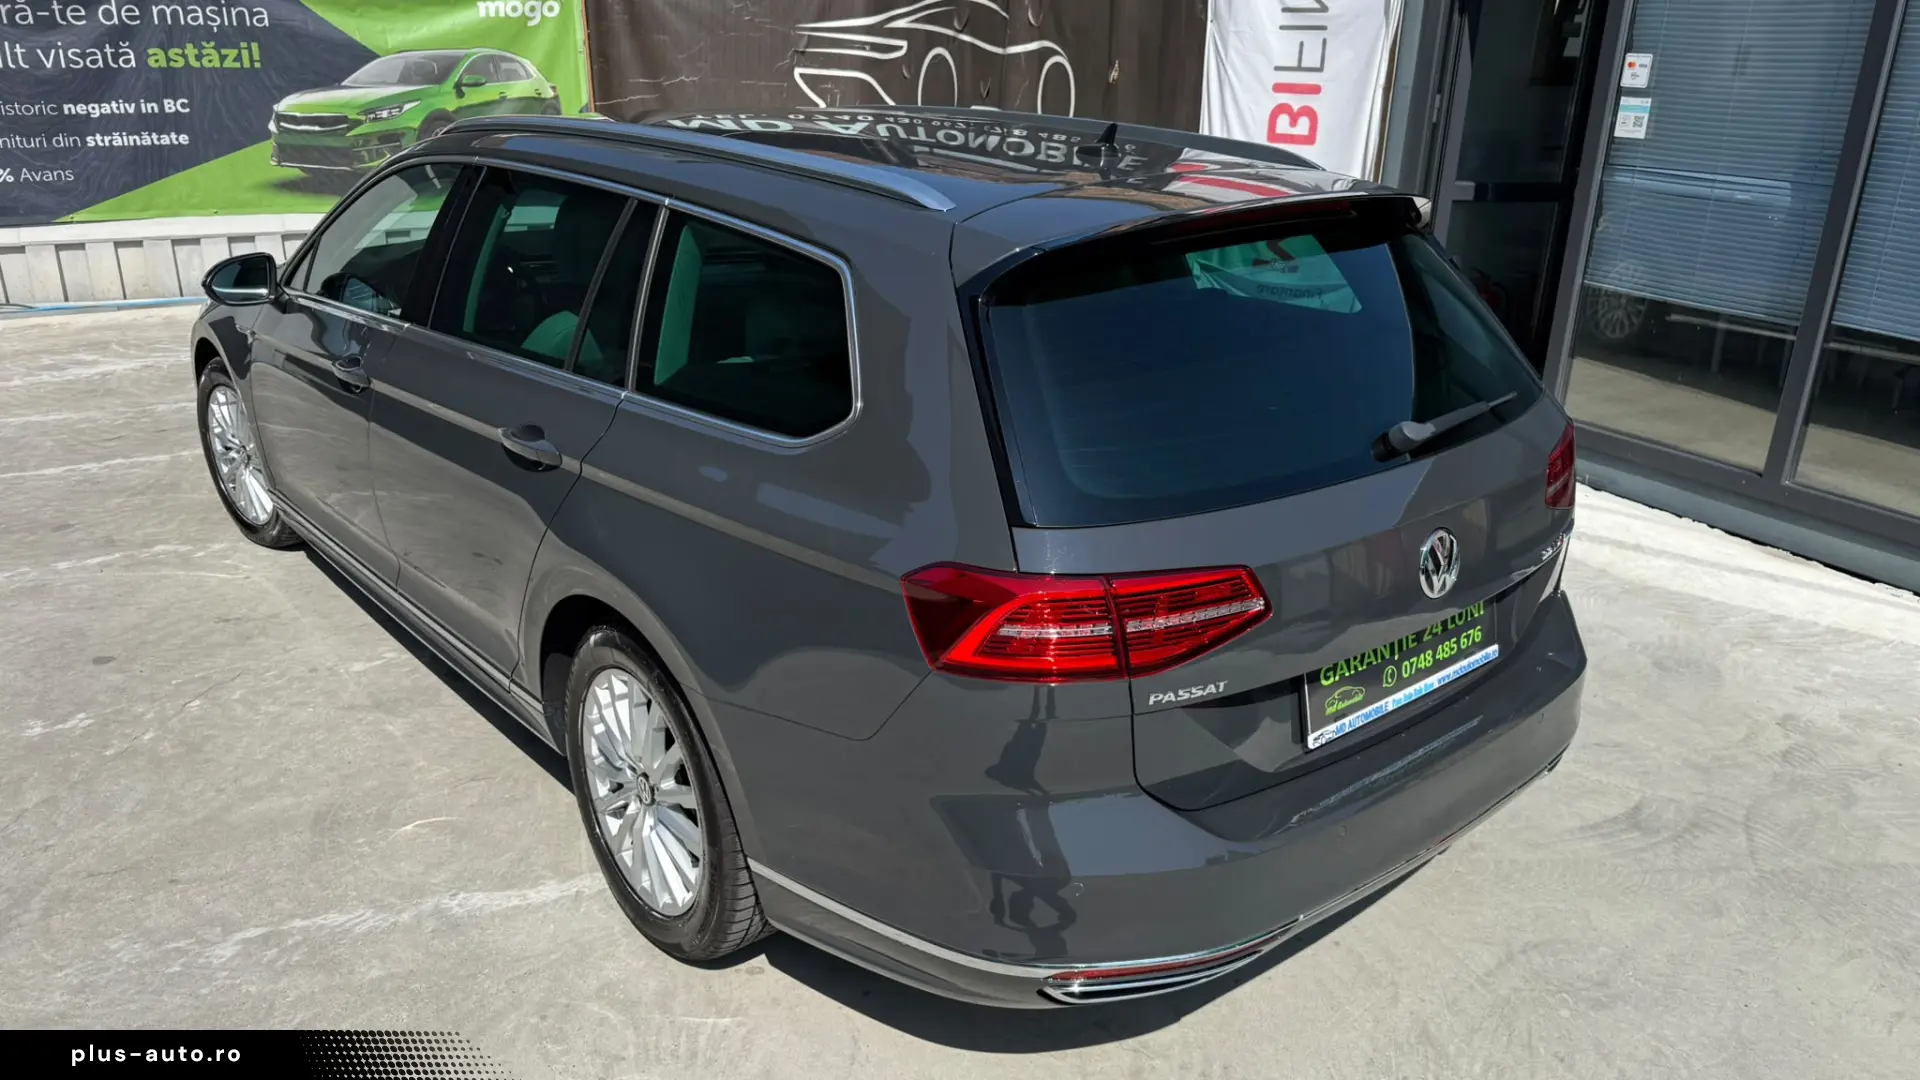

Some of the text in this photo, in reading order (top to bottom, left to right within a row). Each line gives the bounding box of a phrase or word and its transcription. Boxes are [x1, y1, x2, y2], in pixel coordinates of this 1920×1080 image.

[98, 0, 141, 25] de
[152, 0, 270, 33] mașina
[476, 0, 561, 27] mogo
[0, 41, 262, 69] lt visată astăzi!
[0, 98, 191, 118] istoric negativ in BC
[52, 133, 81, 148] din
[86, 131, 190, 147] străinătate
[20, 167, 75, 182] Avans
[1447, 599, 1485, 631] LUNI
[1402, 625, 1483, 679] 0748 485 676
[1148, 680, 1229, 706] PASSAT
